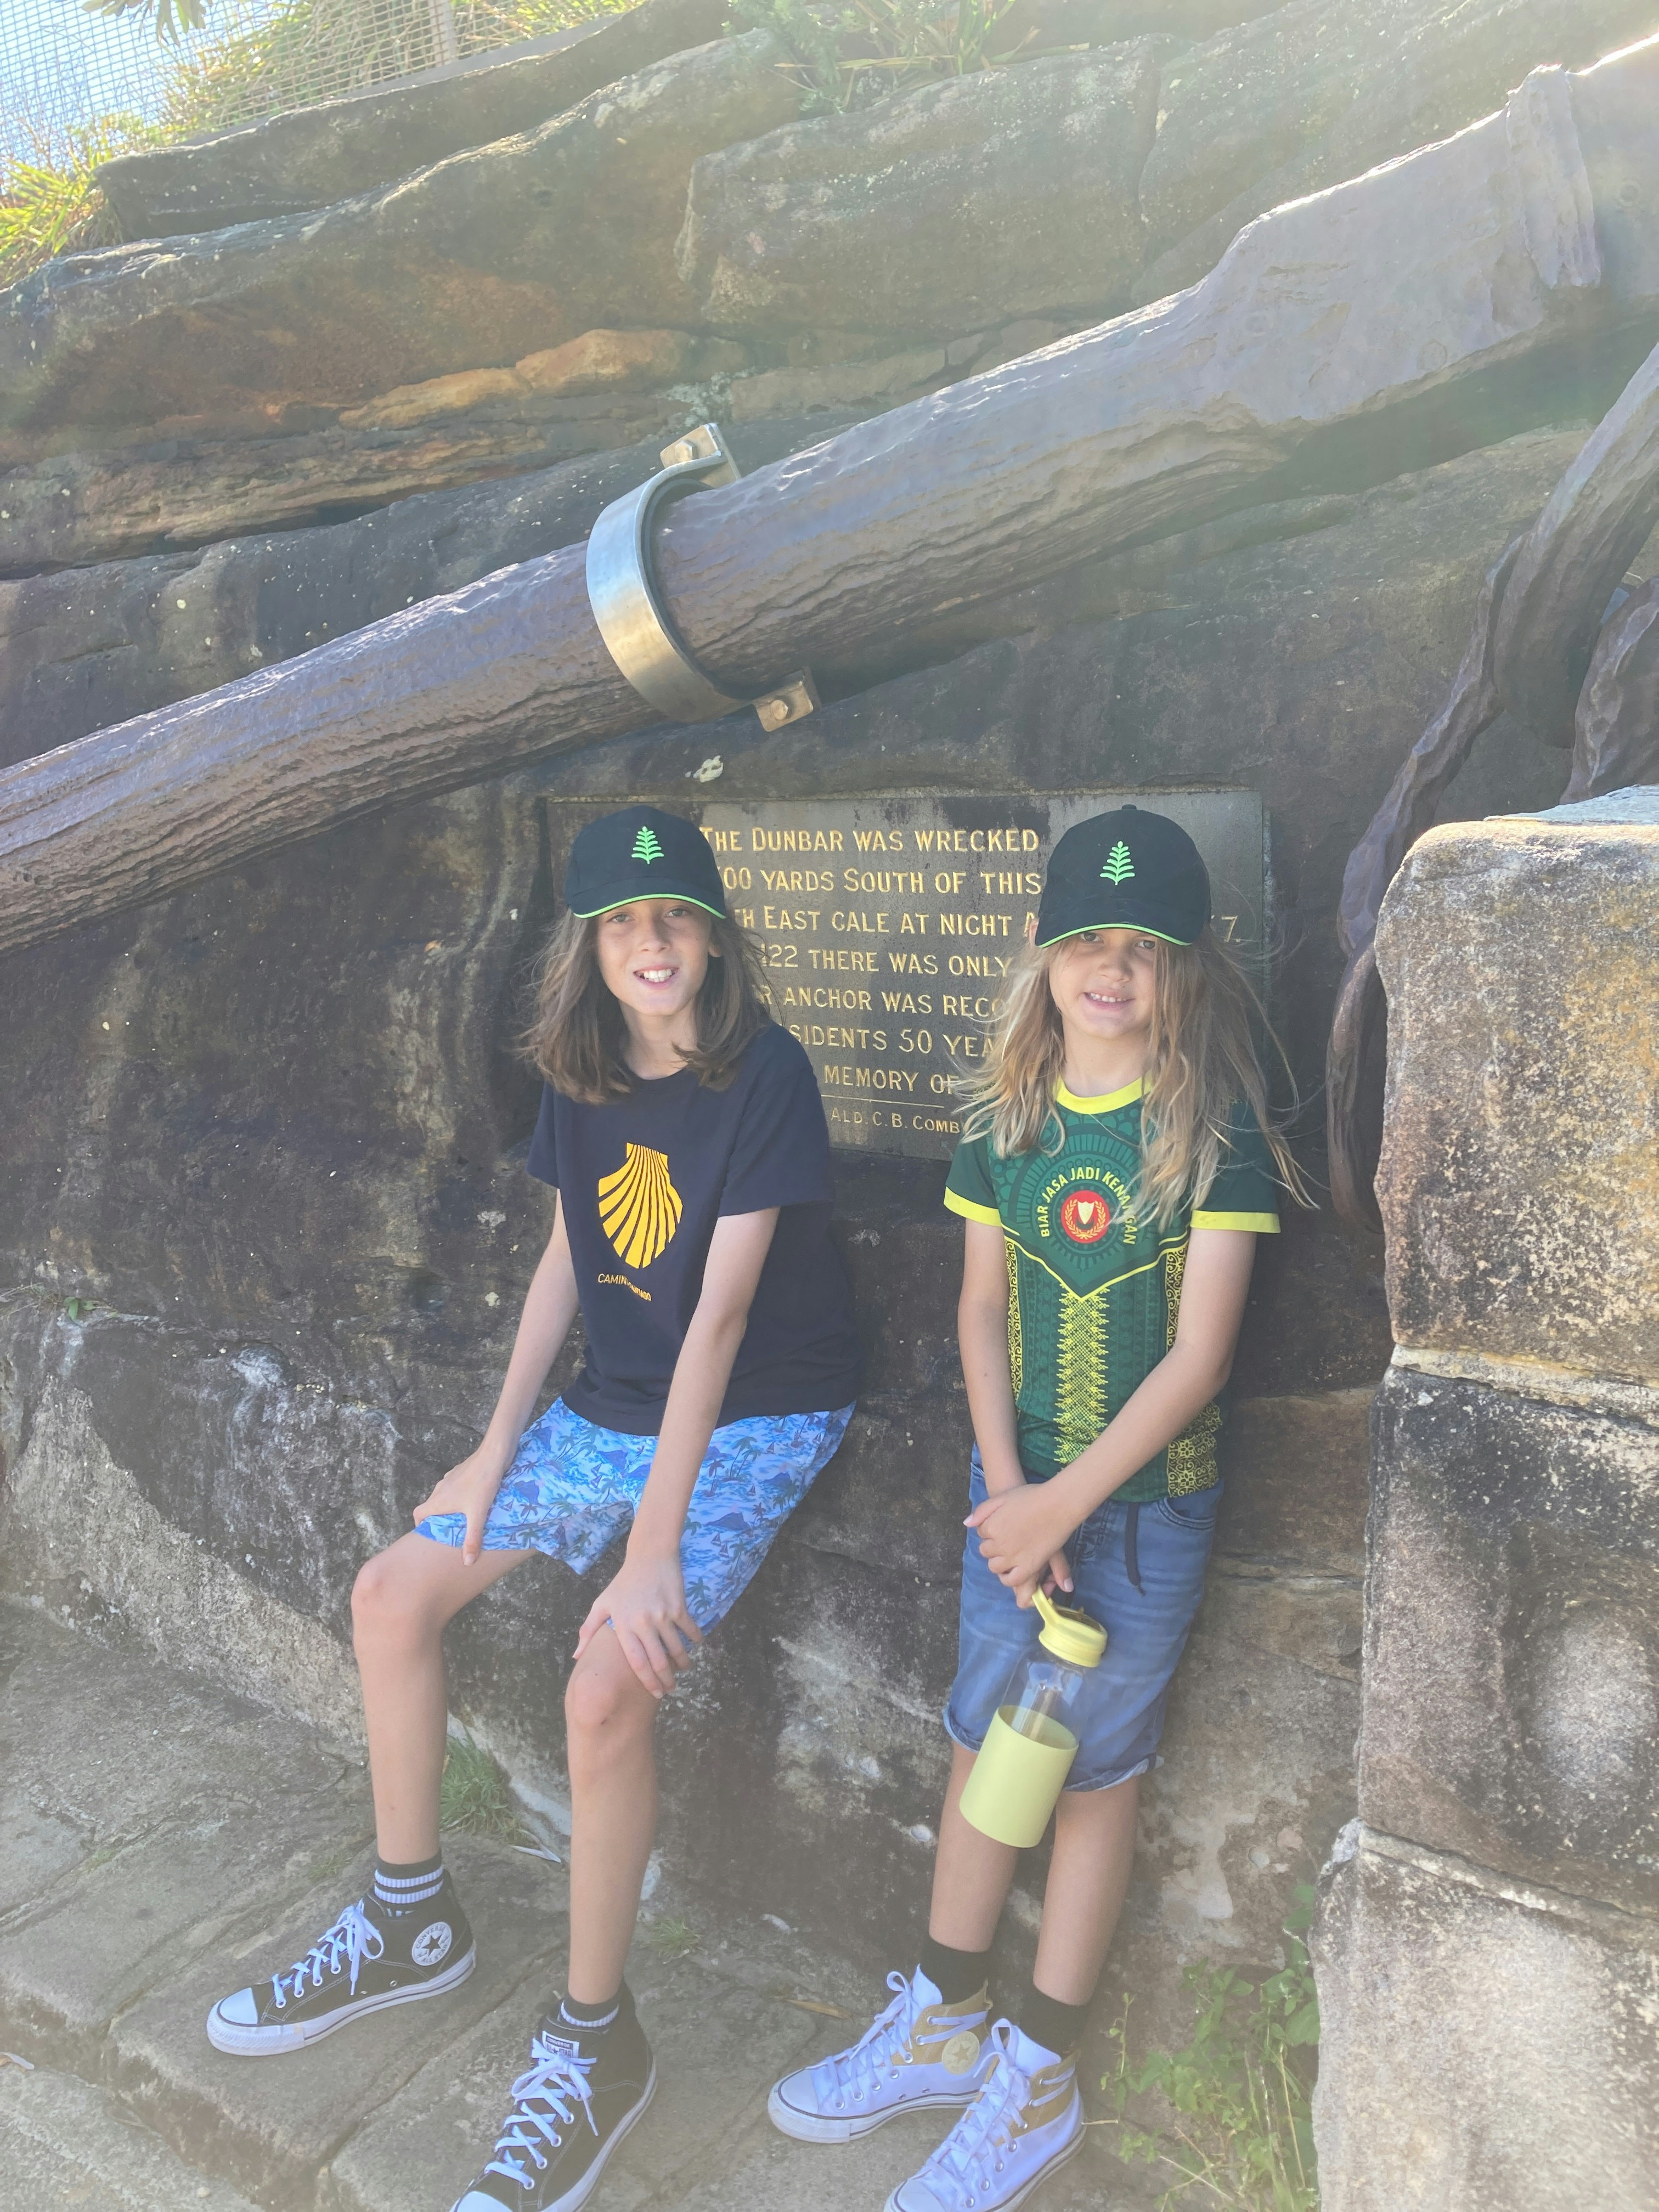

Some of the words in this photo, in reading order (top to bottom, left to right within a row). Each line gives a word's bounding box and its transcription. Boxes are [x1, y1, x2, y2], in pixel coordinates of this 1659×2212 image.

[699, 827, 742, 851] THE
[752, 827, 844, 851] DUNBAR
[853, 830, 904, 852] WAS
[914, 828, 1039, 852] WRECKED
[717, 866, 752, 890] 00
[760, 870, 834, 892] YARDS
[844, 867, 924, 894] SOUTH
[935, 871, 966, 894] OF
[980, 871, 1042, 895] THIS
[764, 905, 821, 930] EAST
[831, 911, 890, 932] GALE
[900, 912, 929, 934] AT
[940, 912, 1012, 936] NIGHT
[808, 949, 879, 972] THERE
[888, 952, 939, 975] WAS
[949, 955, 1012, 977] ONLY
[783, 986, 872, 1011] ANCHOR
[881, 990, 932, 1014] WAS
[779, 1023, 887, 1051] SIDENTS
[898, 1028, 932, 1054] 50
[824, 1064, 919, 1092] MEMORY
[930, 1074, 960, 1095] OF
[1042, 1173, 1069, 1203] JASA
[1070, 1166, 1100, 1181] JADI
[1037, 1205, 1050, 1238] BIAR
